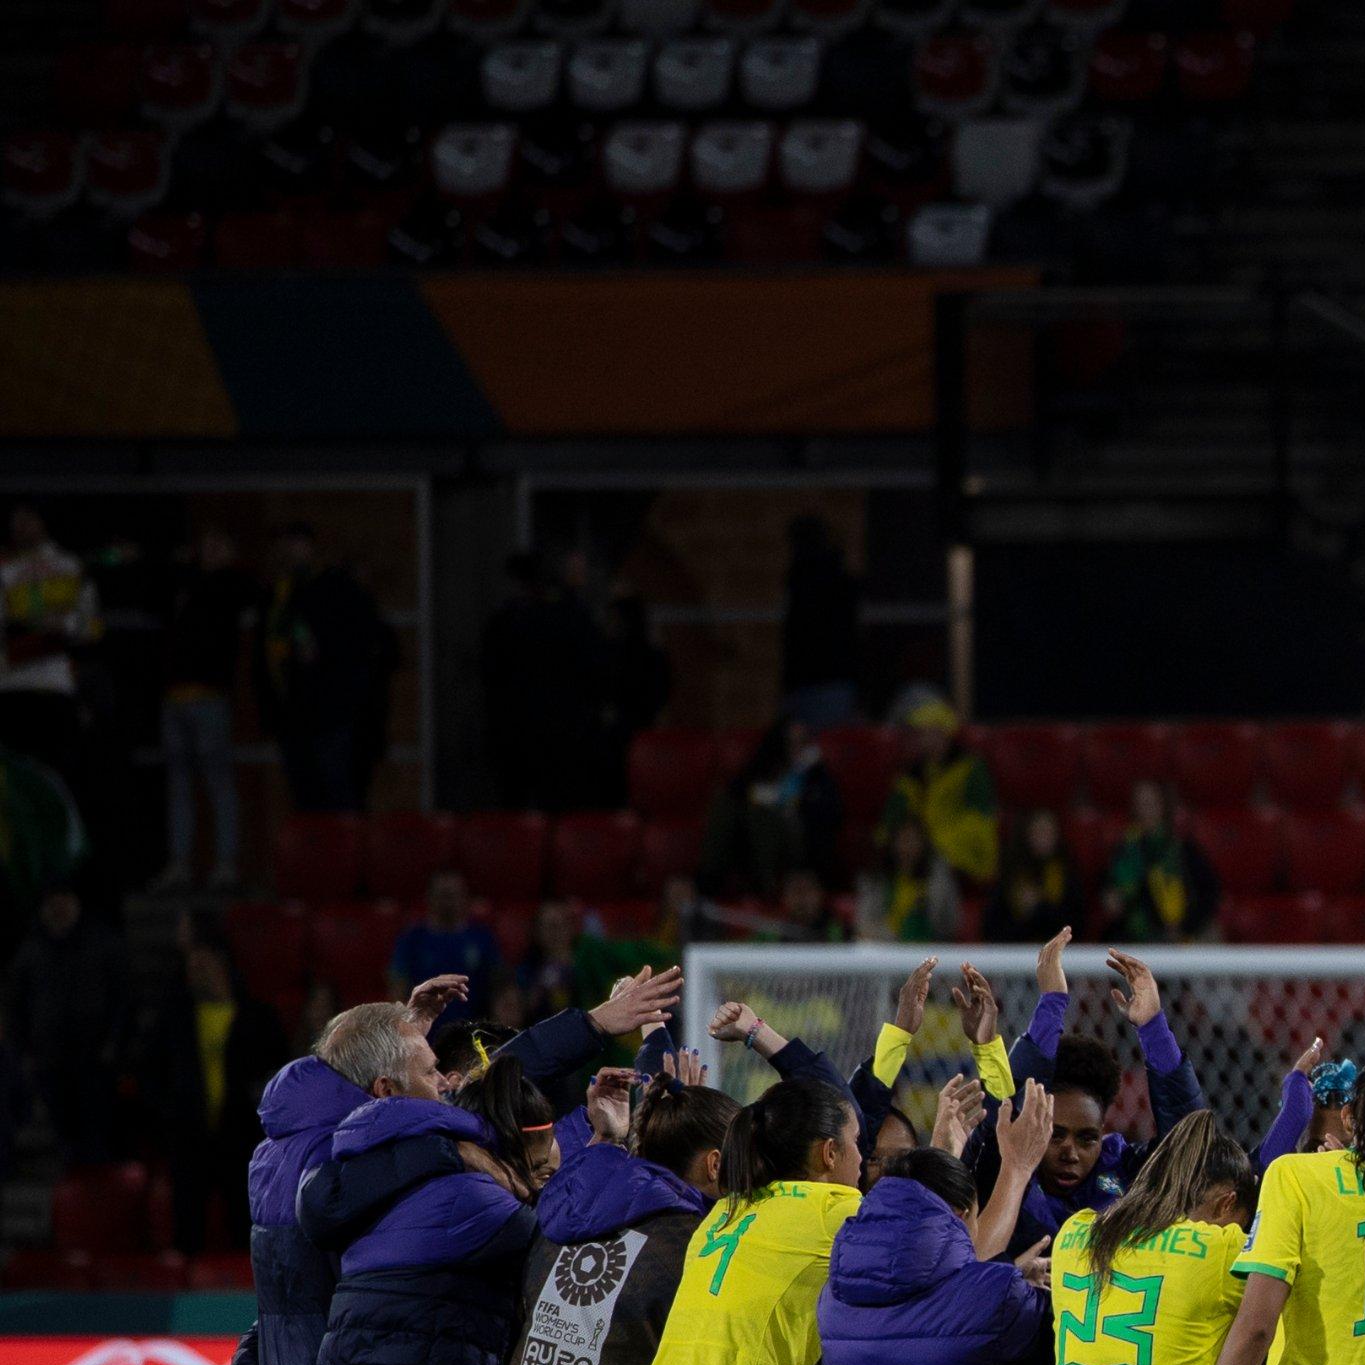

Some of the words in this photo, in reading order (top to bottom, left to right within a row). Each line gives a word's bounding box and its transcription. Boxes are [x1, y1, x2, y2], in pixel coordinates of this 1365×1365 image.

[699, 1212, 757, 1296] 4
[537, 1300, 561, 1317] FIFA
[535, 1312, 580, 1334] WOMEN'S
[533, 1323, 563, 1340] WORLD
[562, 1332, 586, 1347] CUP
[526, 1341, 554, 1364] AU
